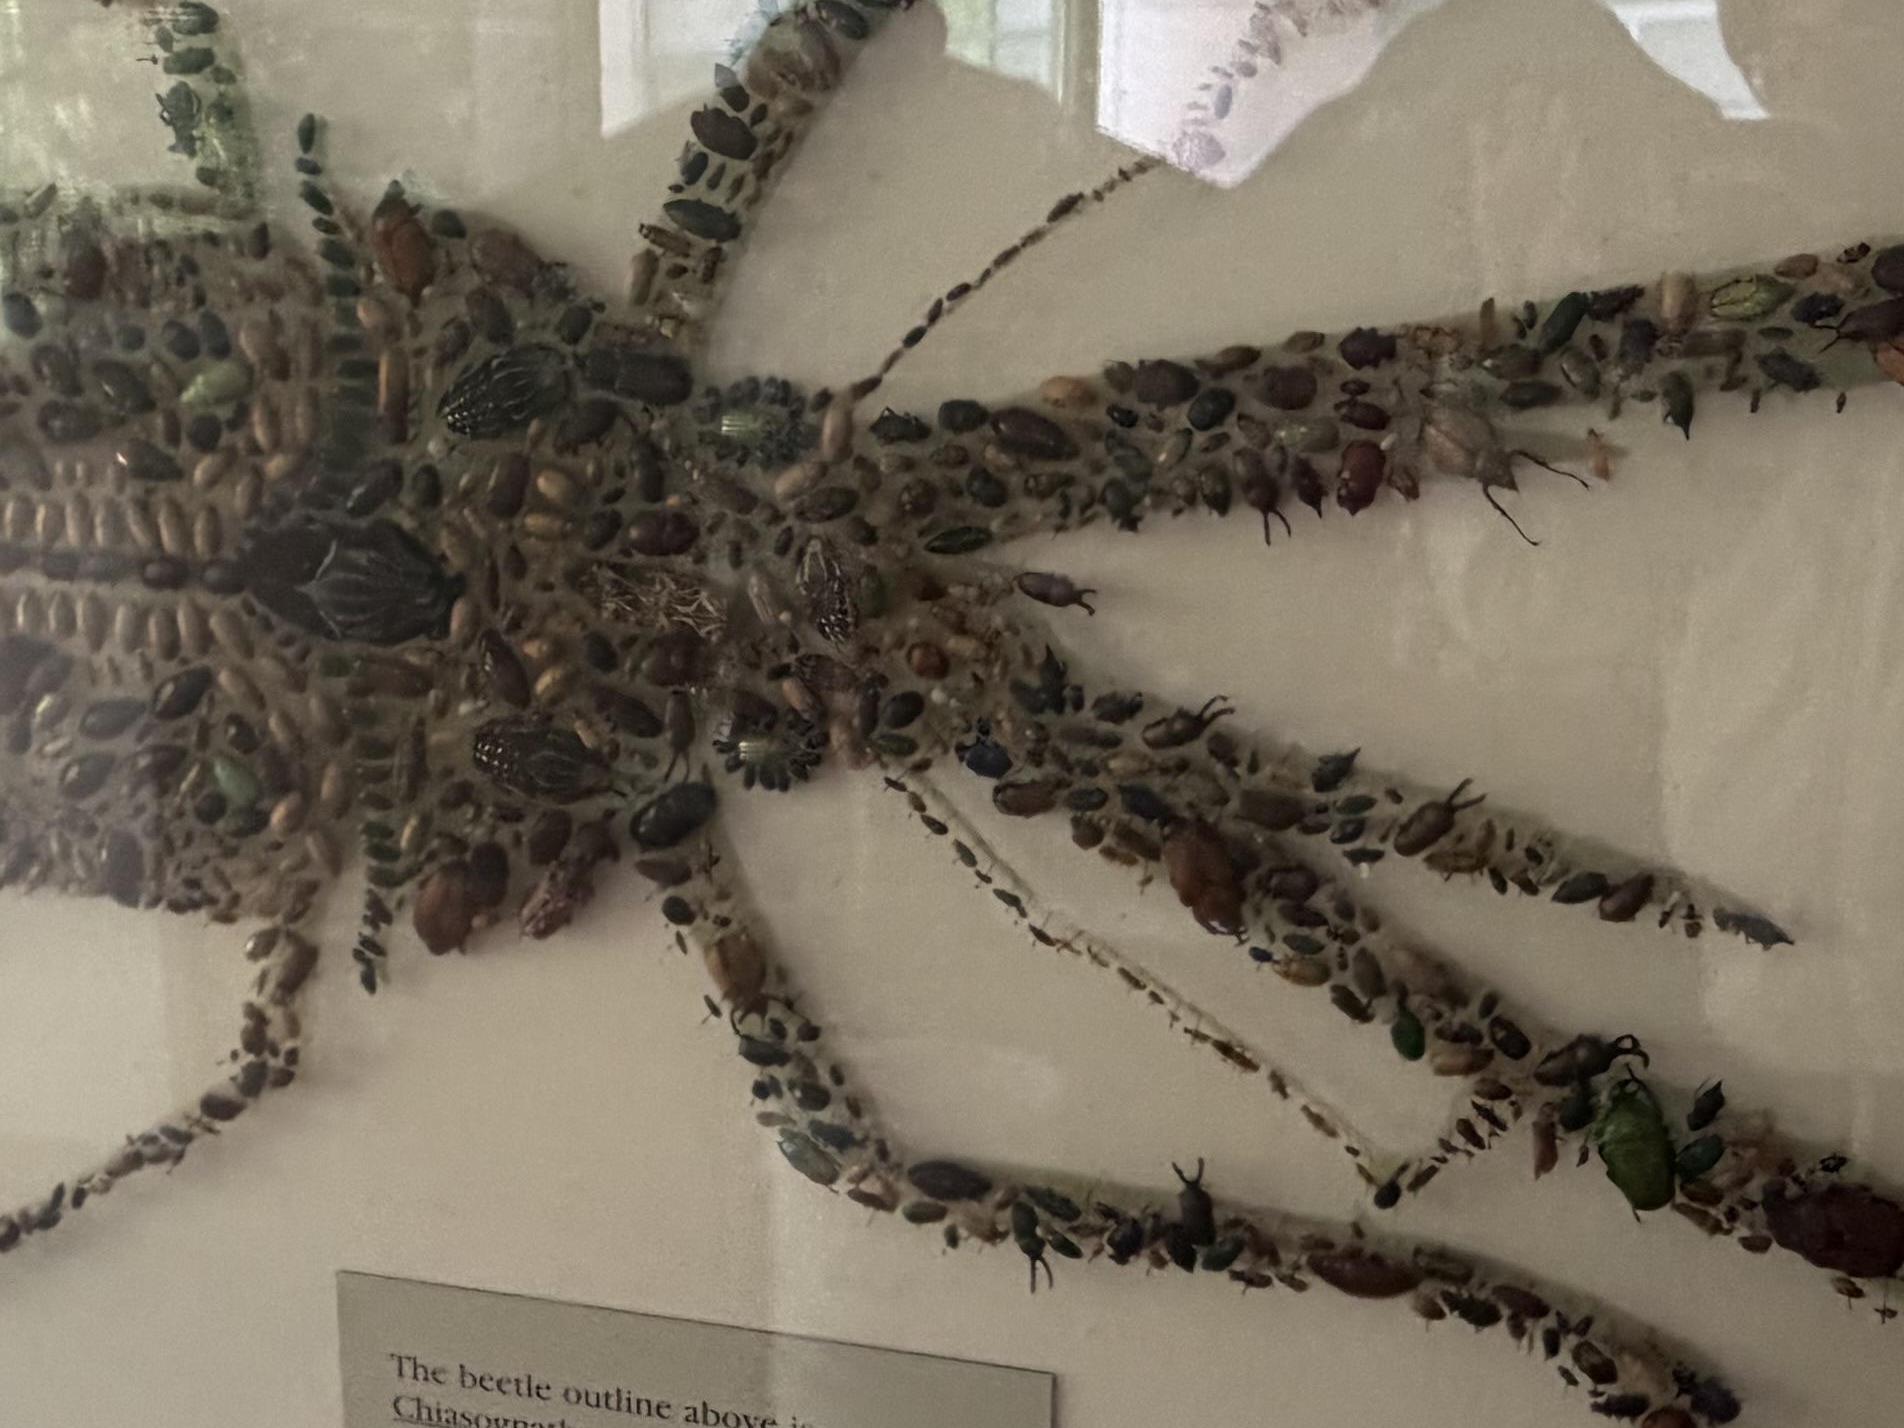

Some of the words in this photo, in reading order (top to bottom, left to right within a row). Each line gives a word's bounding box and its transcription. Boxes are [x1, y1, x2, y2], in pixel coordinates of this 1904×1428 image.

[390, 1353, 447, 1385] The
[459, 1364, 551, 1401] beetle
[563, 1386, 672, 1420] outline
